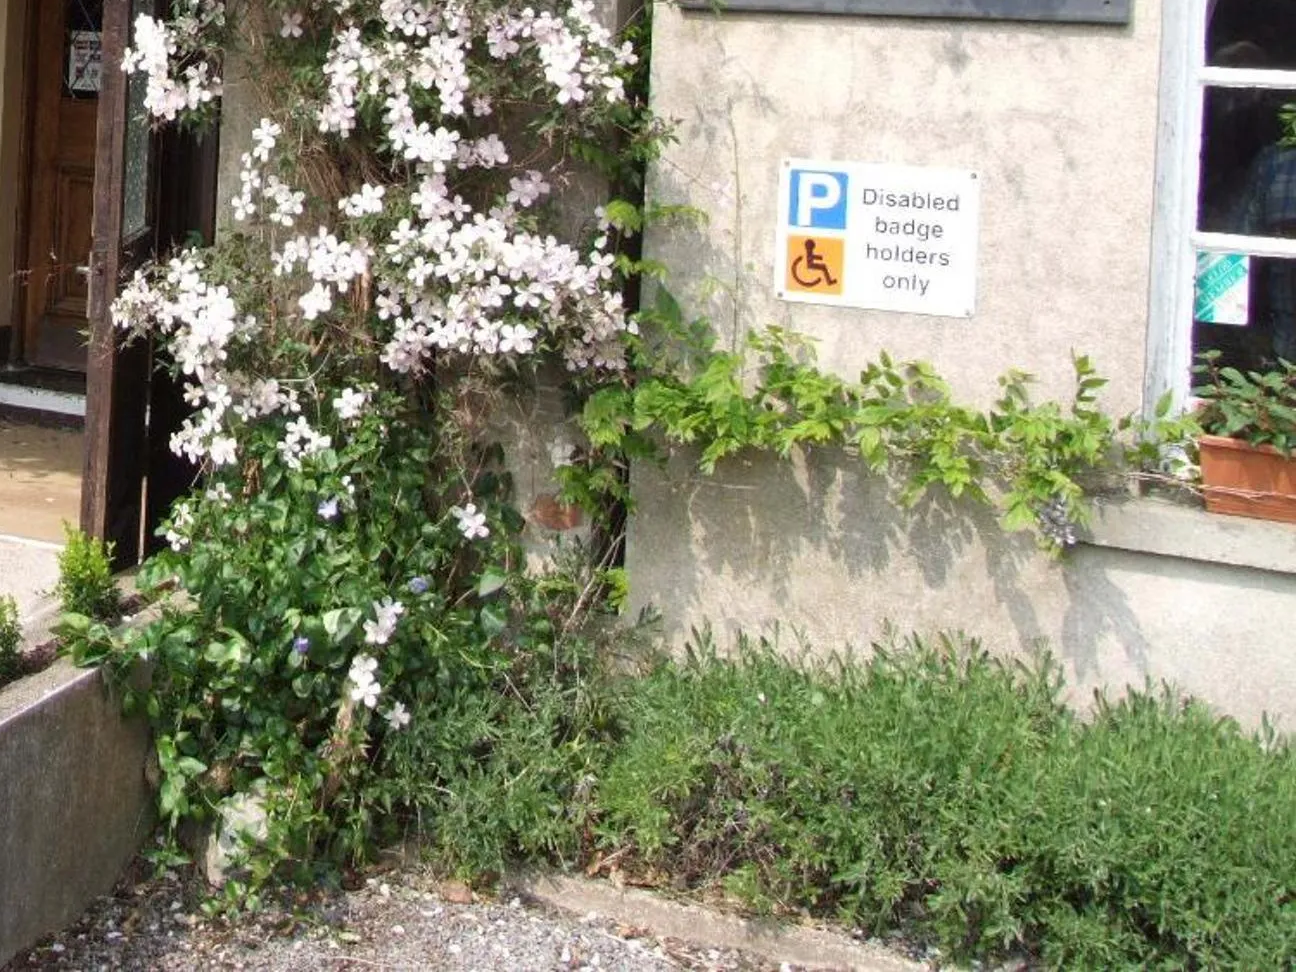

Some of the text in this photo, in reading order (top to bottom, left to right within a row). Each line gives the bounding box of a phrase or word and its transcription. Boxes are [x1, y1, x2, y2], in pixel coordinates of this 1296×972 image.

[796, 172, 842, 228] P
[862, 188, 961, 212] Disabled
[874, 216, 945, 242] badge
[865, 243, 951, 267] holders
[882, 274, 931, 296] only
